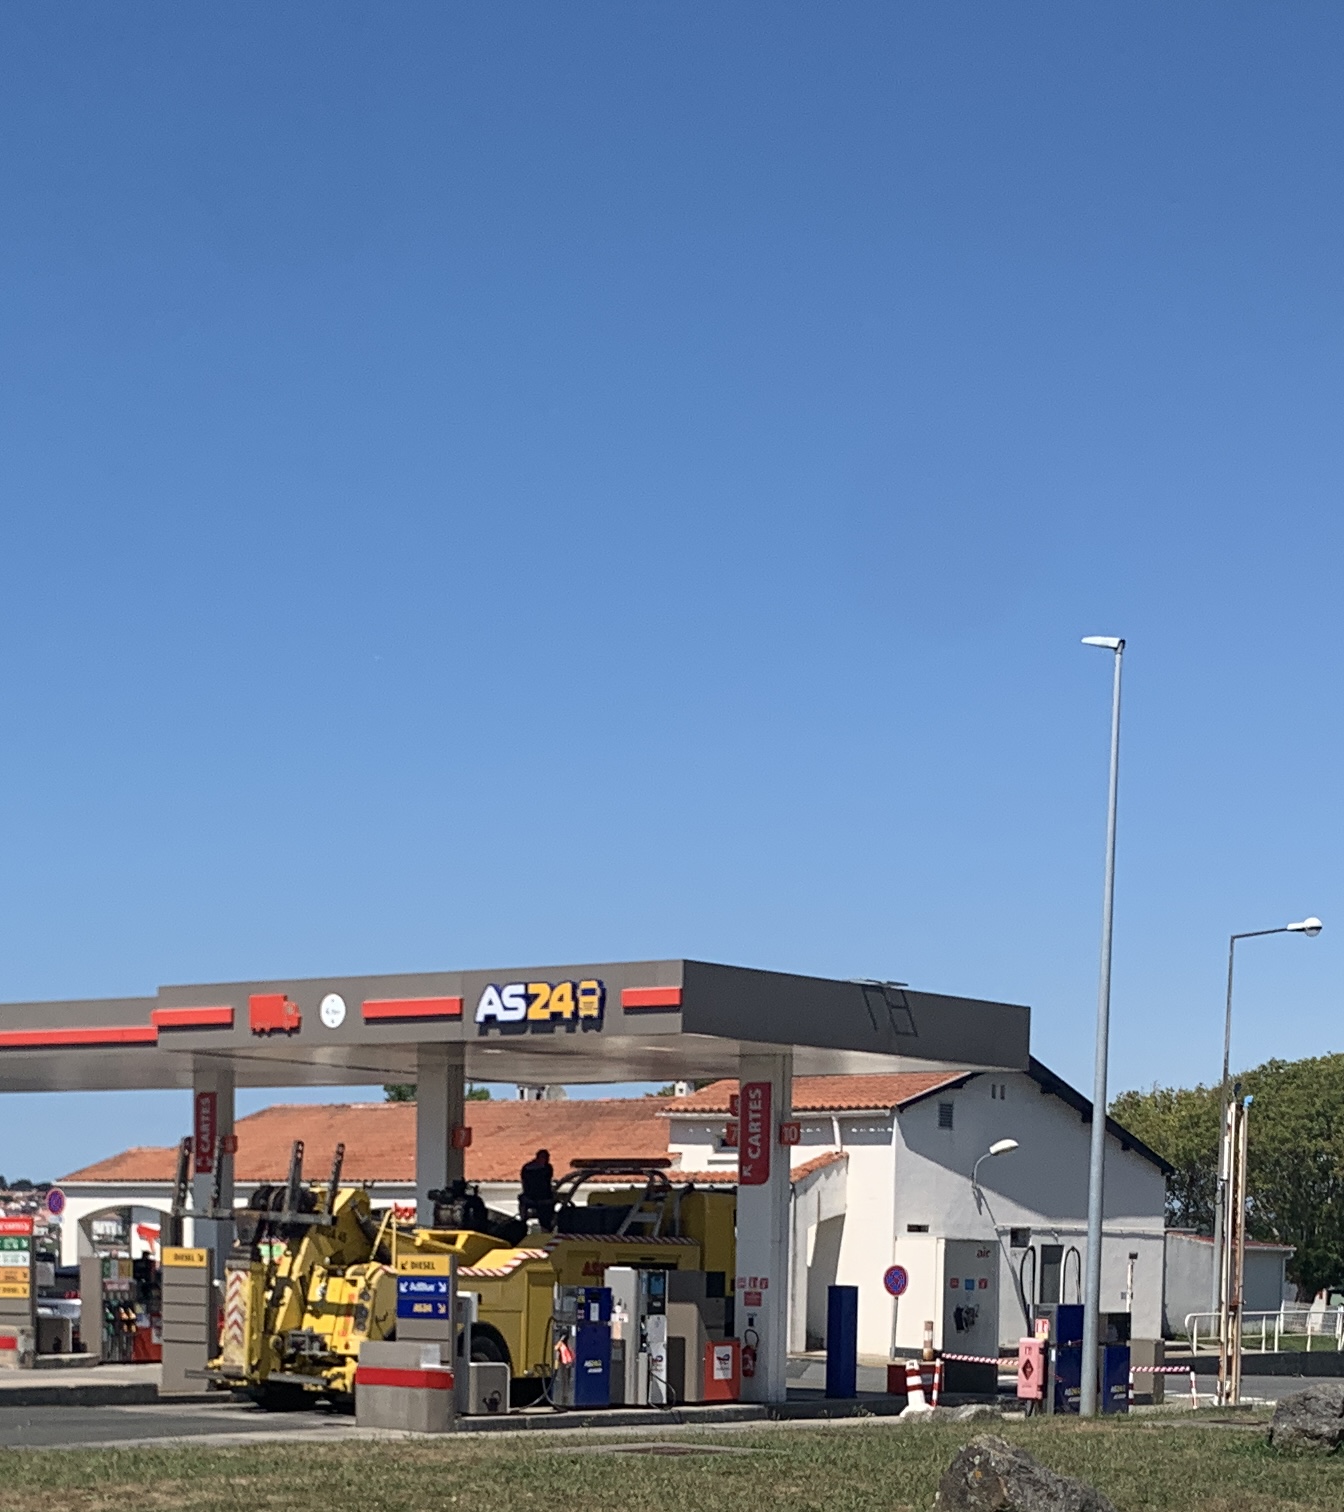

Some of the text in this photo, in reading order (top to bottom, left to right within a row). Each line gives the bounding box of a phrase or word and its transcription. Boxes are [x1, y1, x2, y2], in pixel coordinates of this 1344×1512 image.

[475, 982, 576, 1023] AS24
[199, 1097, 211, 1153] CARTES
[747, 1088, 762, 1159] CARTES
[783, 1126, 798, 1141] 10
[410, 1261, 435, 1270] DIESEL
[976, 1246, 991, 1258] air
